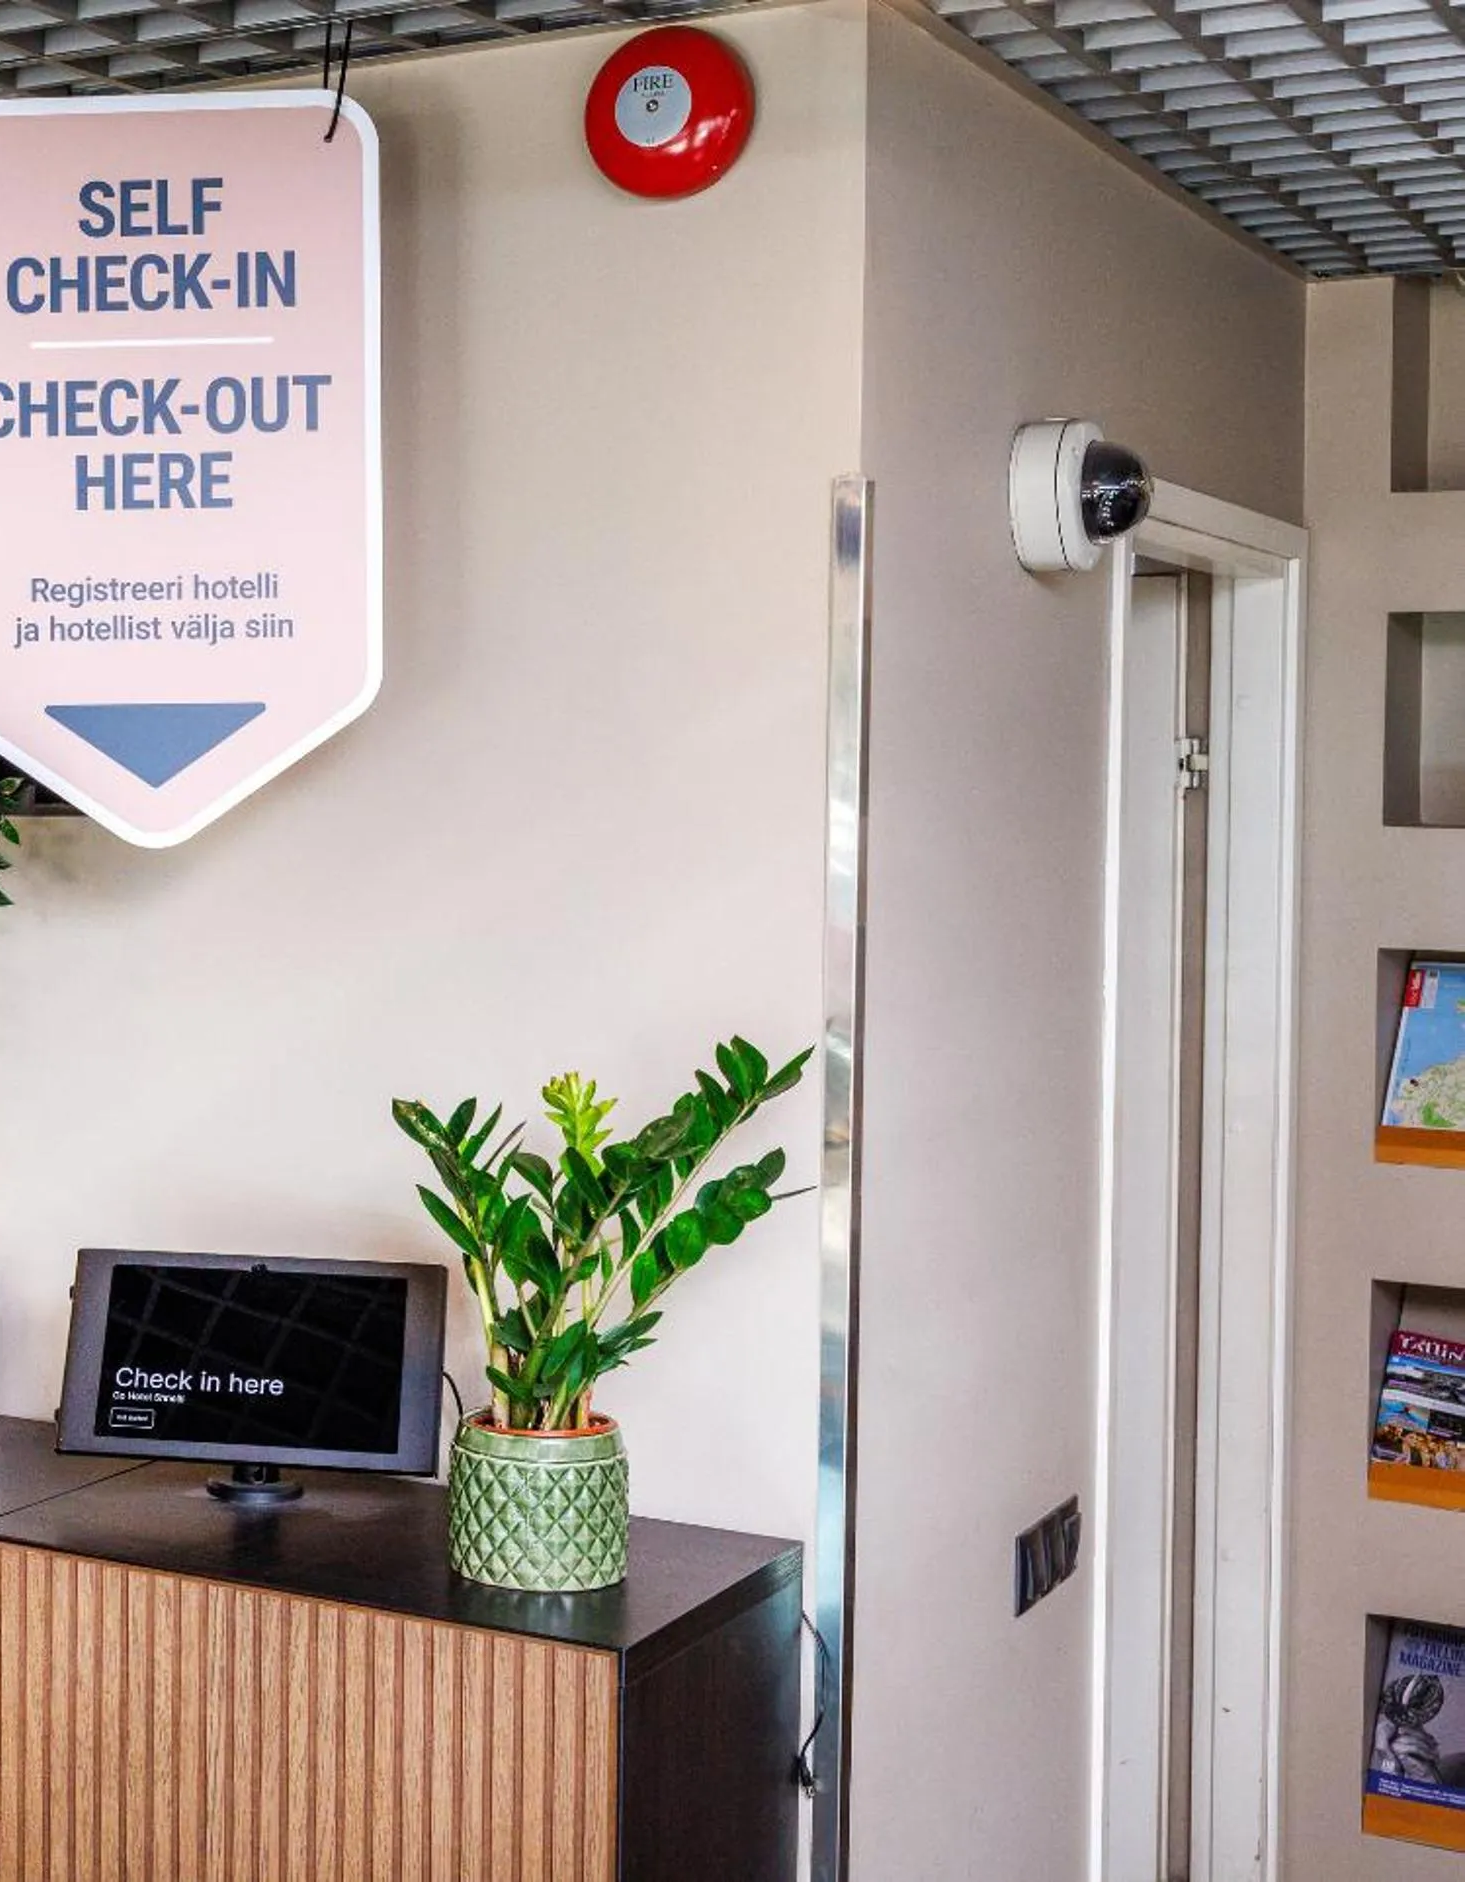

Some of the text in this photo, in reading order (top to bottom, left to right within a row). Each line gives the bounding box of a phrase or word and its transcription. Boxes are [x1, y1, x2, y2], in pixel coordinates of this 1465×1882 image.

[633, 74, 675, 93] FIRE
[78, 178, 224, 238] SELF
[6, 250, 296, 315] CHECK-IN
[75, 451, 233, 511] HERE
[31, 573, 279, 608] Registreeri hotelli
[14, 613, 294, 649] ja hotellist välja siin
[116, 1367, 284, 1395] Check in here
